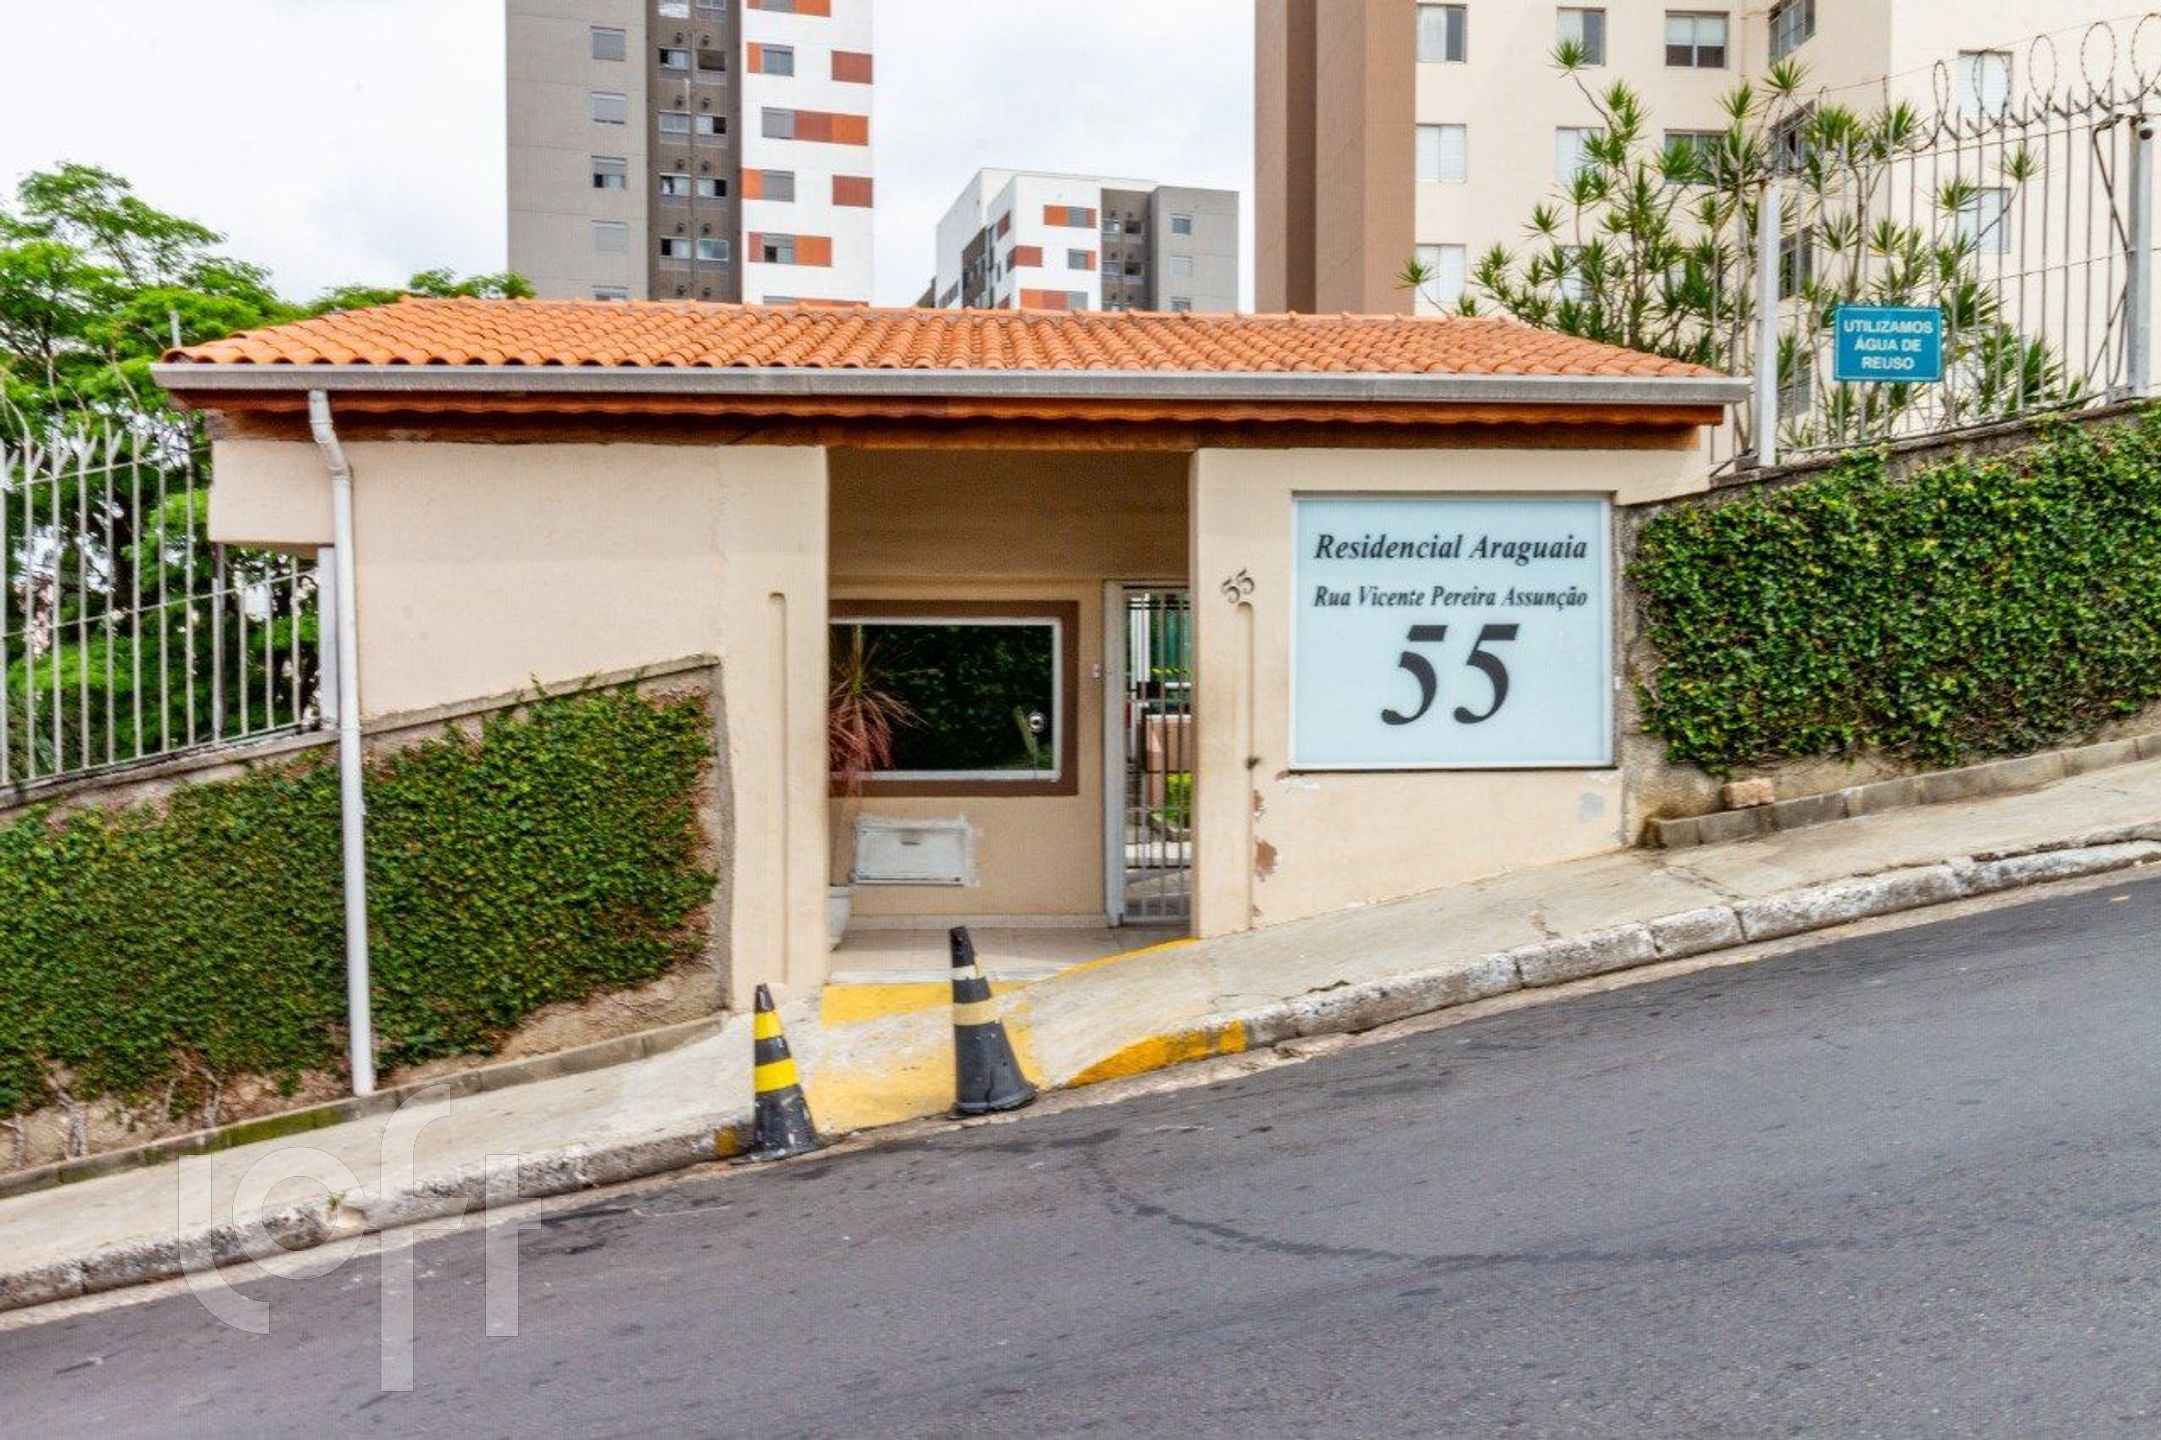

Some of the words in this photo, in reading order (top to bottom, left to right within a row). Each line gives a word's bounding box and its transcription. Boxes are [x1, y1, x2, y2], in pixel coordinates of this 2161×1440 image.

[1843, 319, 1934, 334] UTILIZAMOS
[1854, 335, 1899, 351] ÁGUA
[1901, 339, 1922, 352] DE
[1861, 356, 1915, 370] REUSO
[1313, 533, 1462, 560] Residencial
[1468, 533, 1588, 566] Araguaia
[1220, 567, 1256, 604] 55
[1313, 586, 1351, 607] Rua
[1358, 586, 1427, 607] Vicente
[1431, 586, 1496, 607] Pereira
[1501, 585, 1588, 612] Assunção
[1381, 623, 1520, 726] 55
